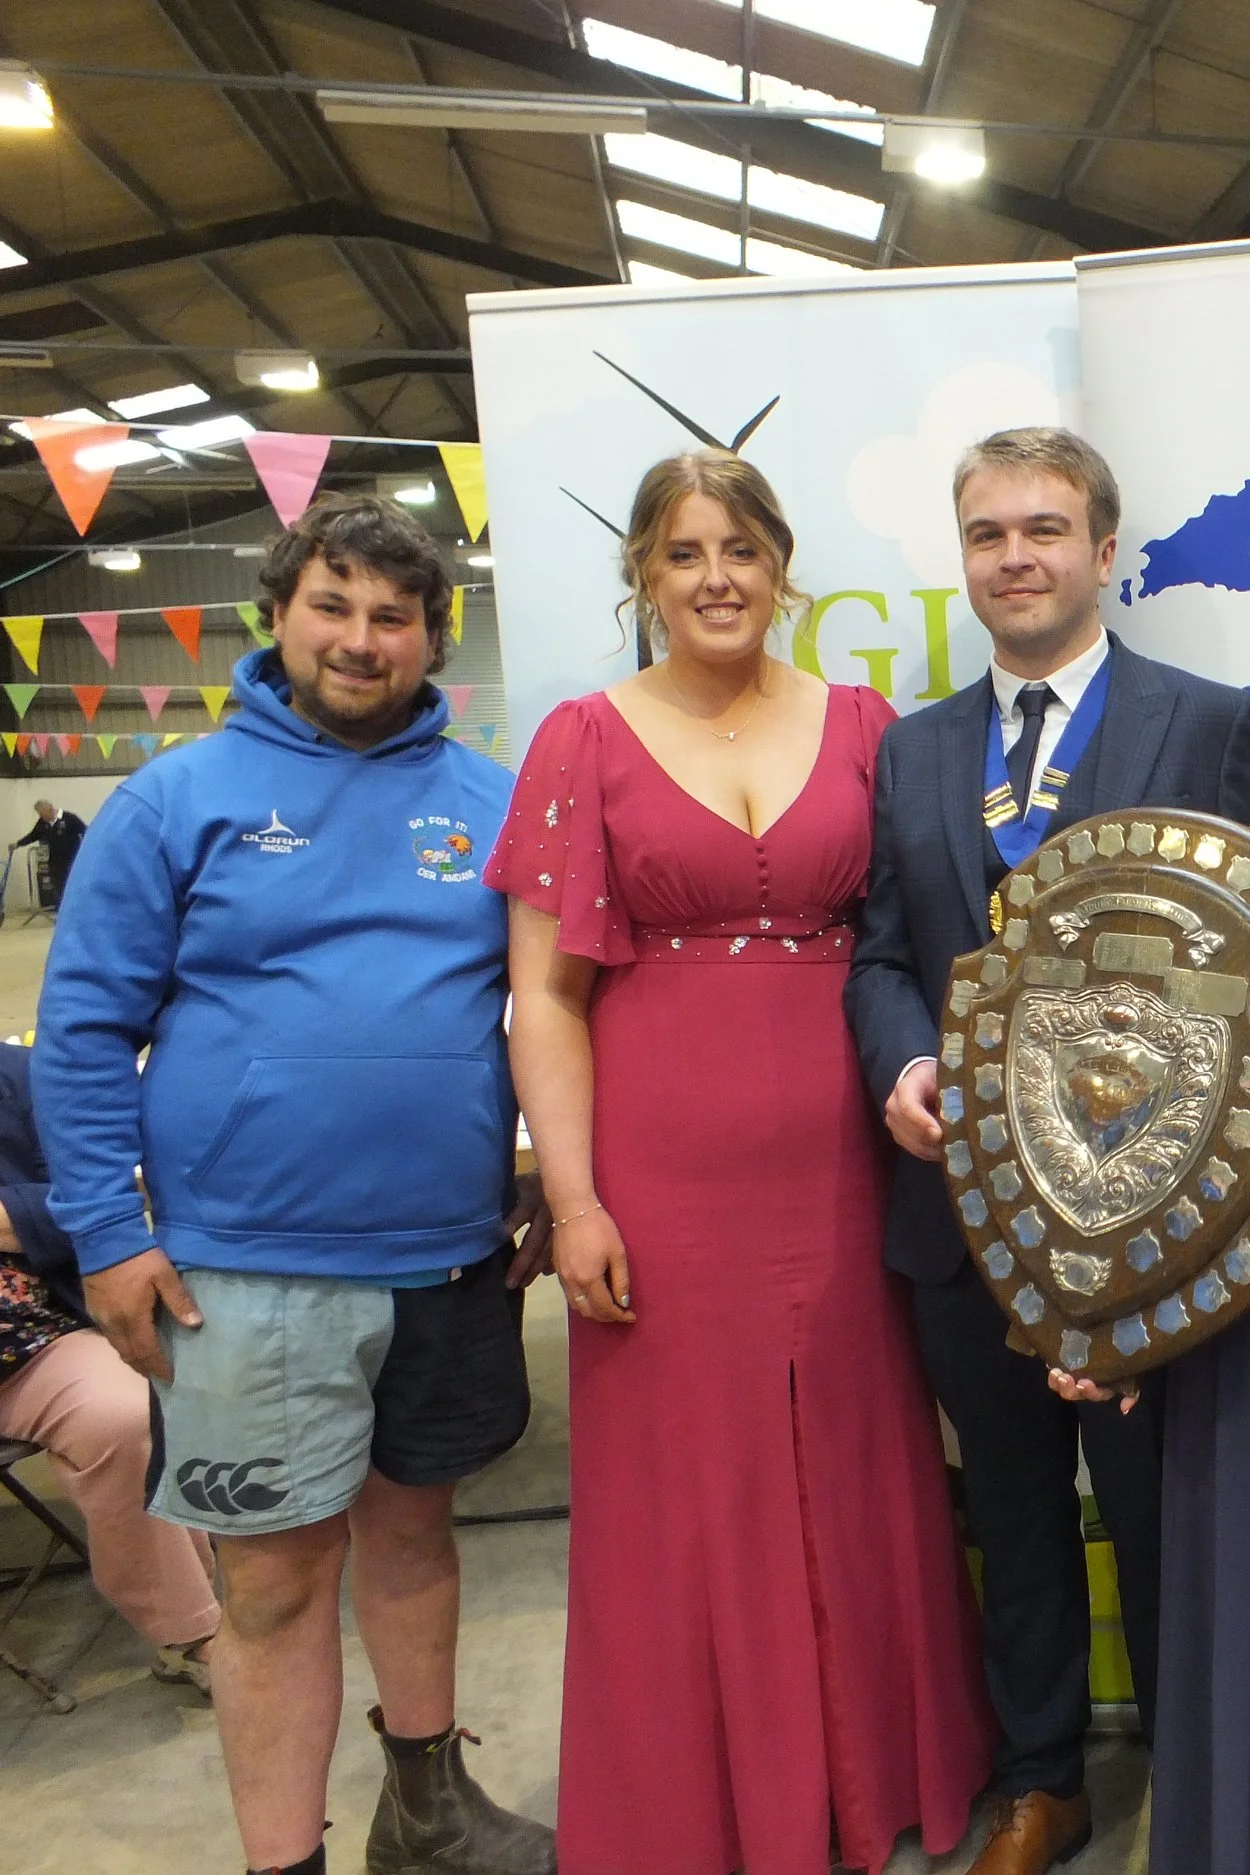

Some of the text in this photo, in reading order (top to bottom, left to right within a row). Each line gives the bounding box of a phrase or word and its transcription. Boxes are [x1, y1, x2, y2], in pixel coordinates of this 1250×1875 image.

[774, 588, 960, 700] GI
[409, 818, 424, 829] GO
[428, 816, 450, 826] FOR
